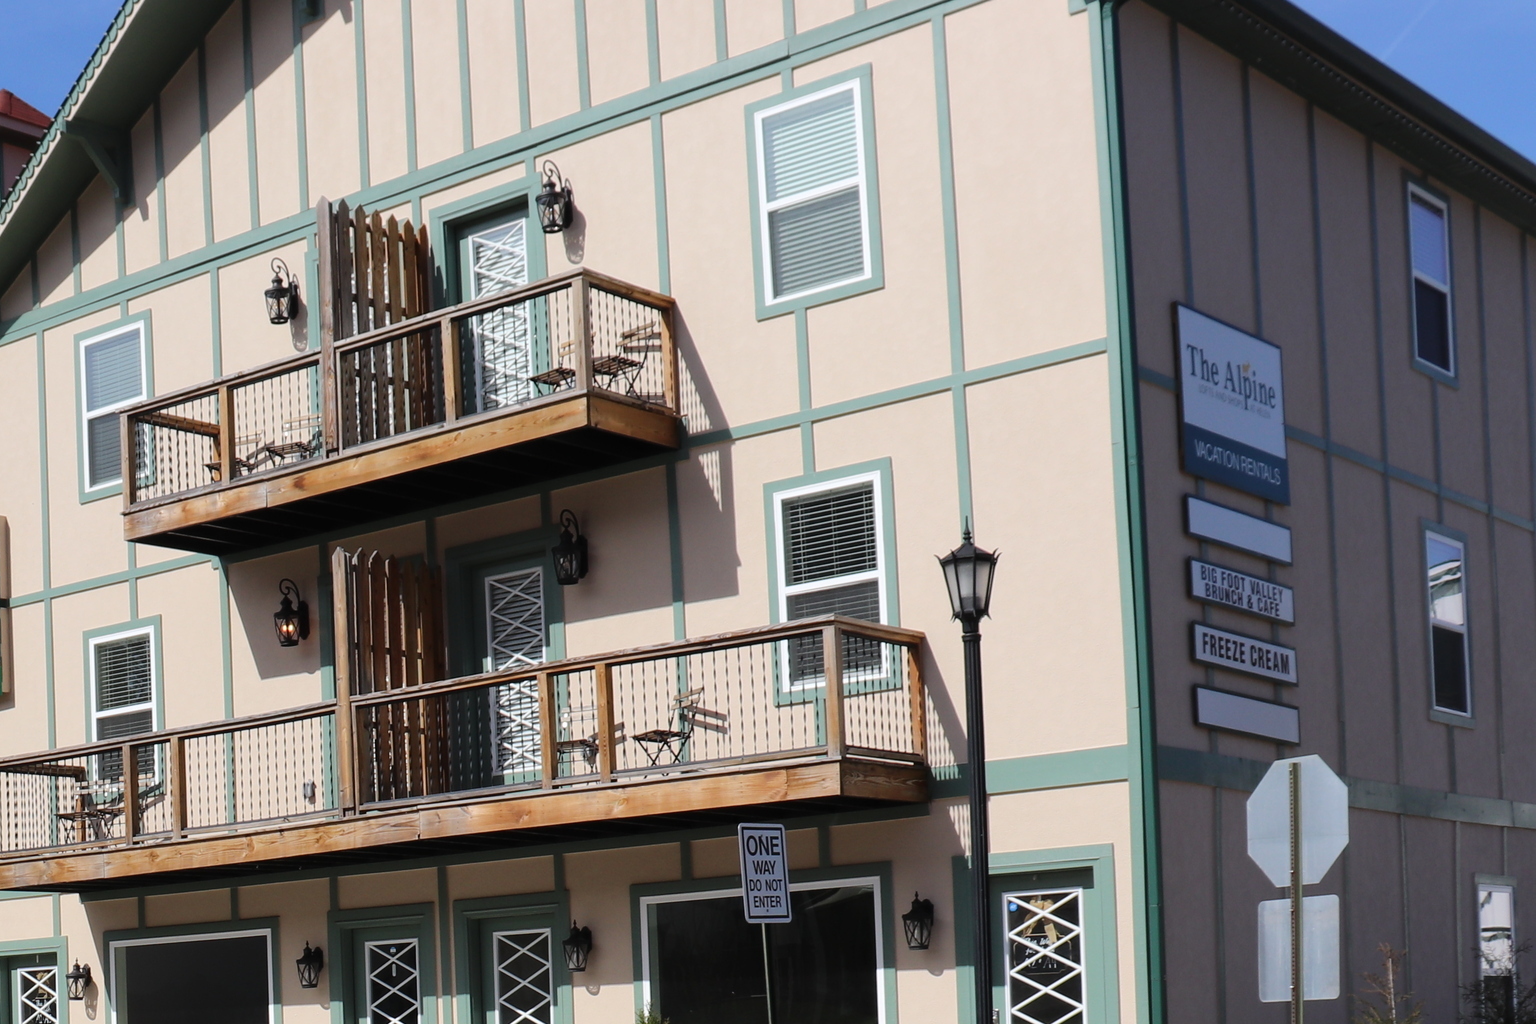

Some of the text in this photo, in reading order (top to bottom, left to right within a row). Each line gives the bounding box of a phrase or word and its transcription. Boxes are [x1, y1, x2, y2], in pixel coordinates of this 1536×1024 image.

[1186, 343, 1219, 386] The
[1224, 361, 1277, 411] Alpine
[1194, 439, 1282, 485] VACATION RENTALS
[1200, 564, 1284, 603] BIG FOOT VALLEY
[1205, 583, 1281, 617] BRUNCH & CAFE
[1202, 632, 1290, 675] FREEZE CREAM
[746, 835, 781, 856] ONE
[752, 860, 776, 875] WAY
[749, 879, 783, 892] DO NOT
[754, 895, 782, 908] ENTER
